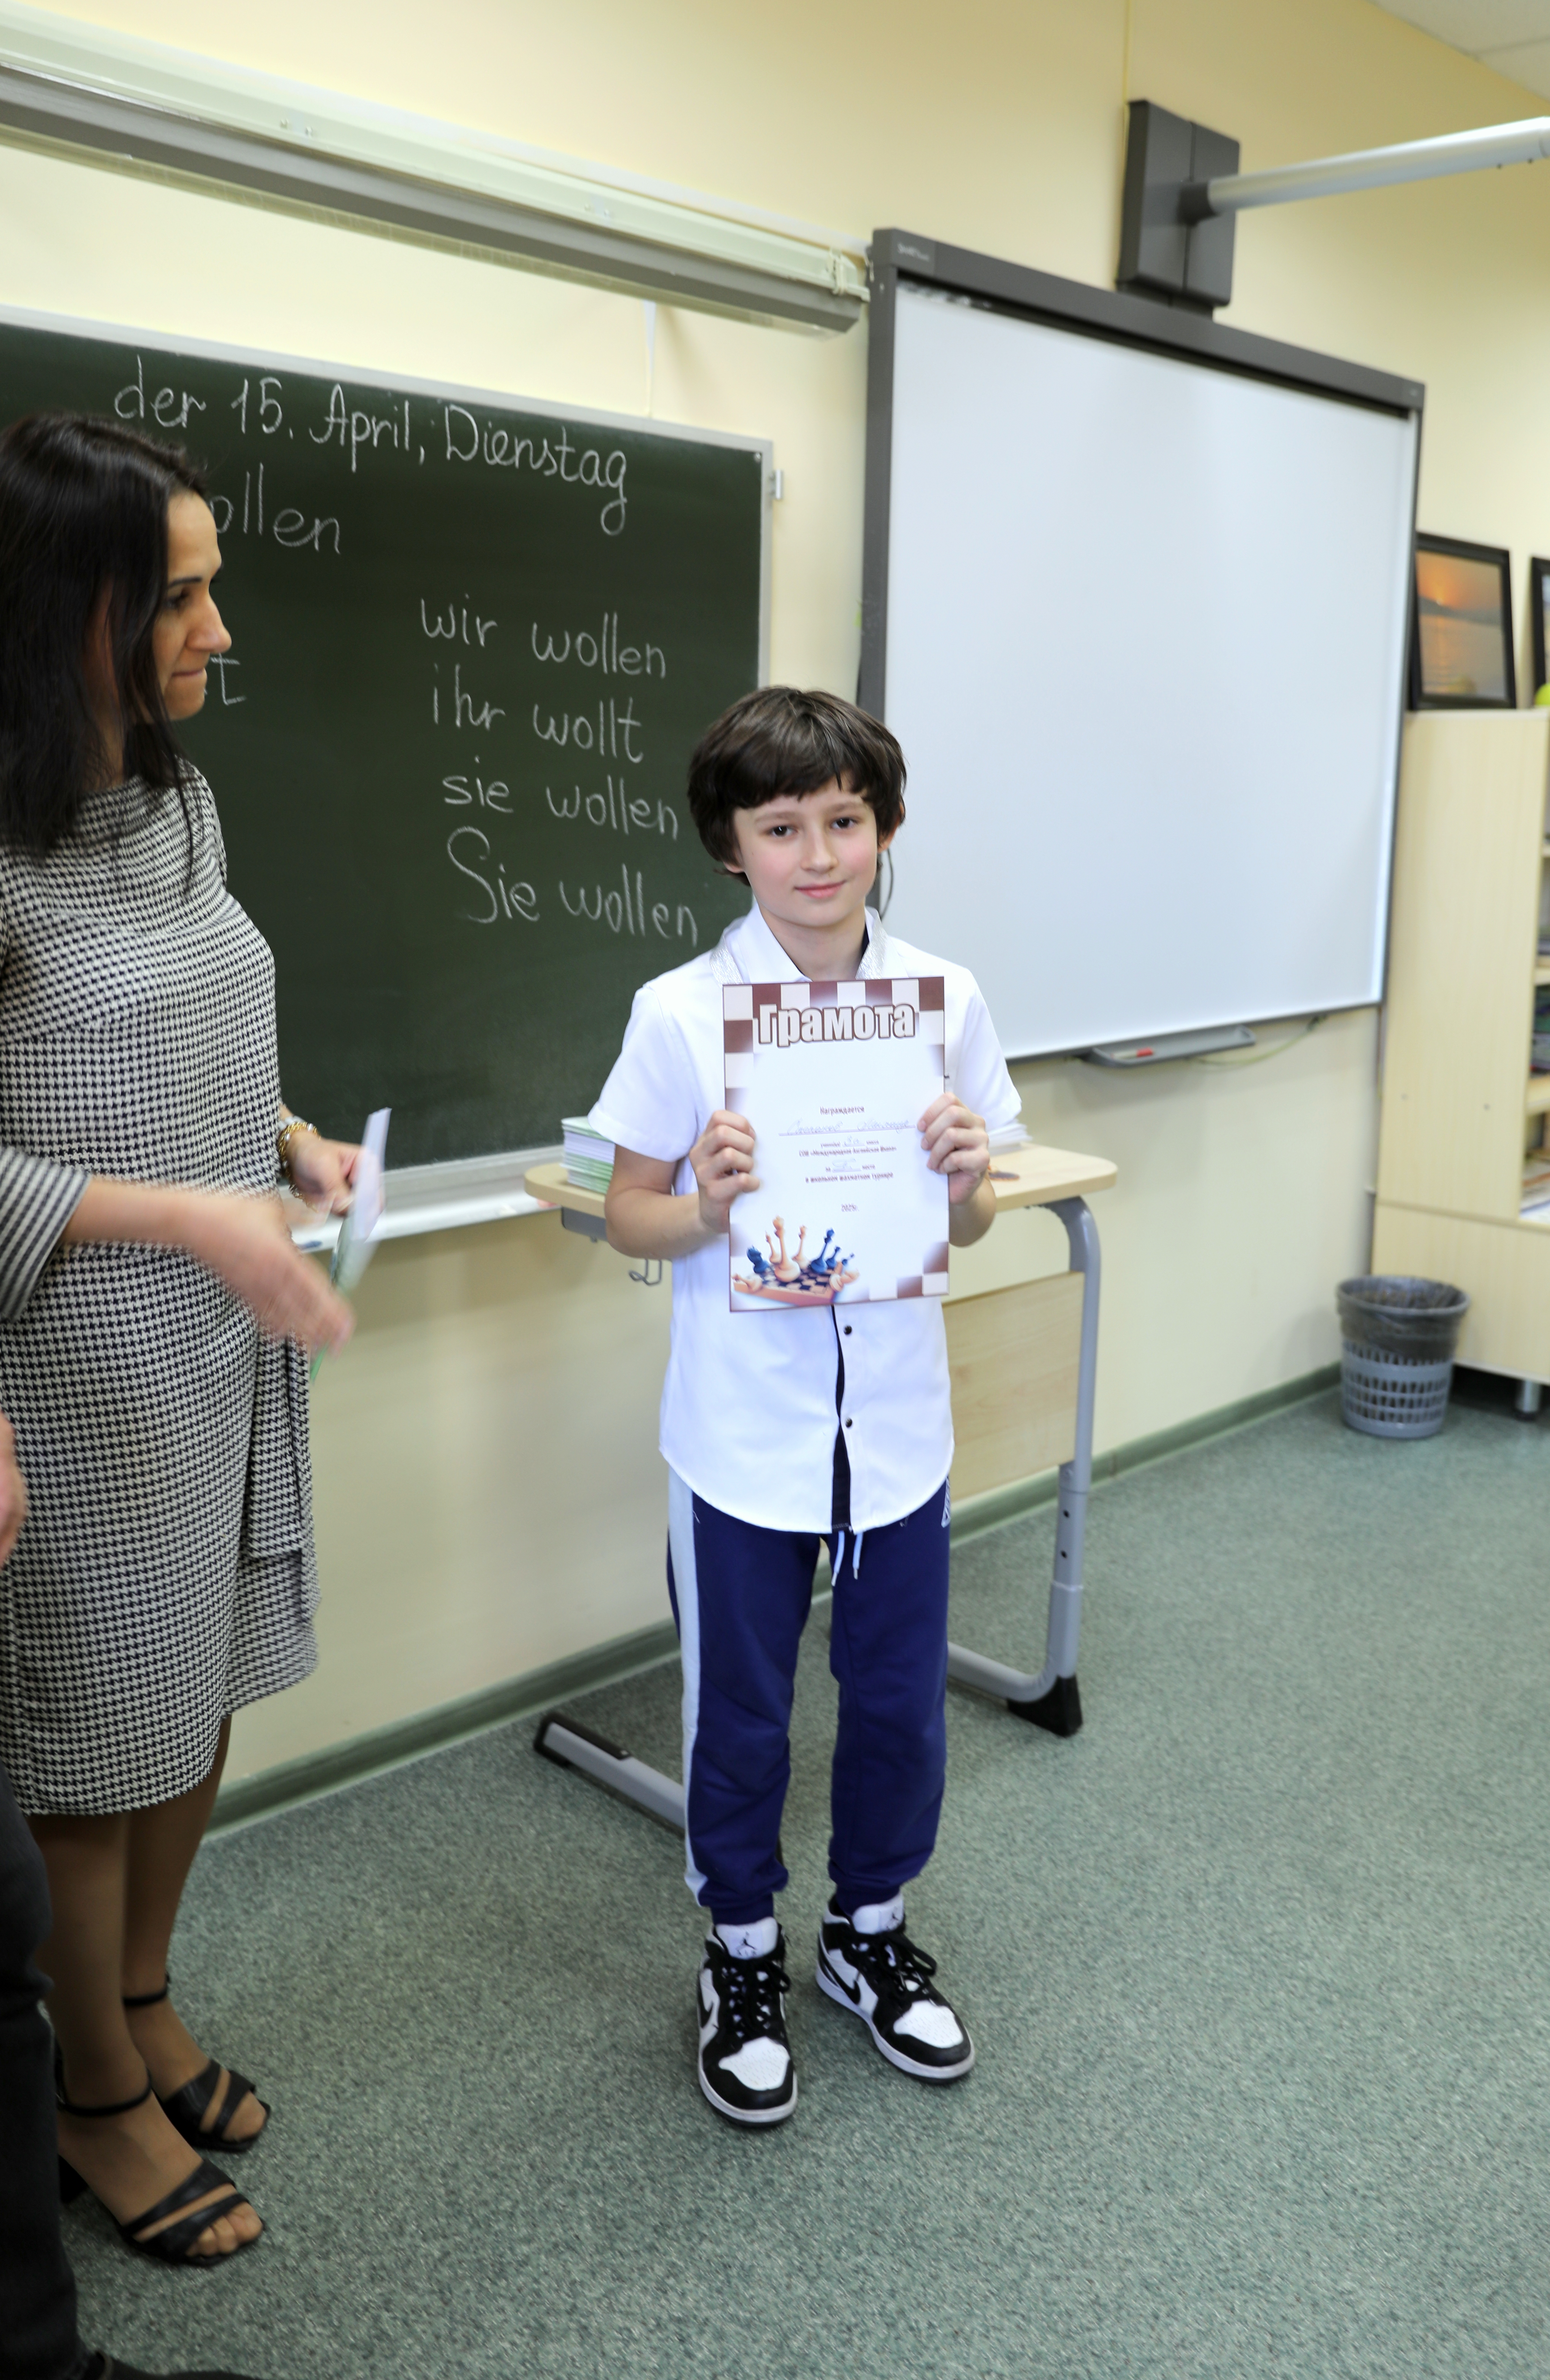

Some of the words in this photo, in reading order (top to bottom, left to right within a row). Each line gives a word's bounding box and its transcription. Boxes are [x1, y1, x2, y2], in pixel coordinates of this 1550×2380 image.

[115, 355, 206, 428] der
[230, 377, 293, 439] 15.
[309, 383, 426, 472] April,
[444, 404, 627, 535] Dienstag
[210, 462, 340, 554] ollen
[421, 594, 498, 647] wir
[531, 612, 666, 678] wollen
[433, 664, 506, 730] ihr
[533, 697, 644, 764] wollt
[442, 756, 513, 813] sie
[546, 775, 679, 840] wollen
[447, 826, 540, 924] Sie
[559, 864, 698, 947] wollen
[759, 1003, 916, 1048] Грамота
[820, 1106, 865, 1116] Награждается
